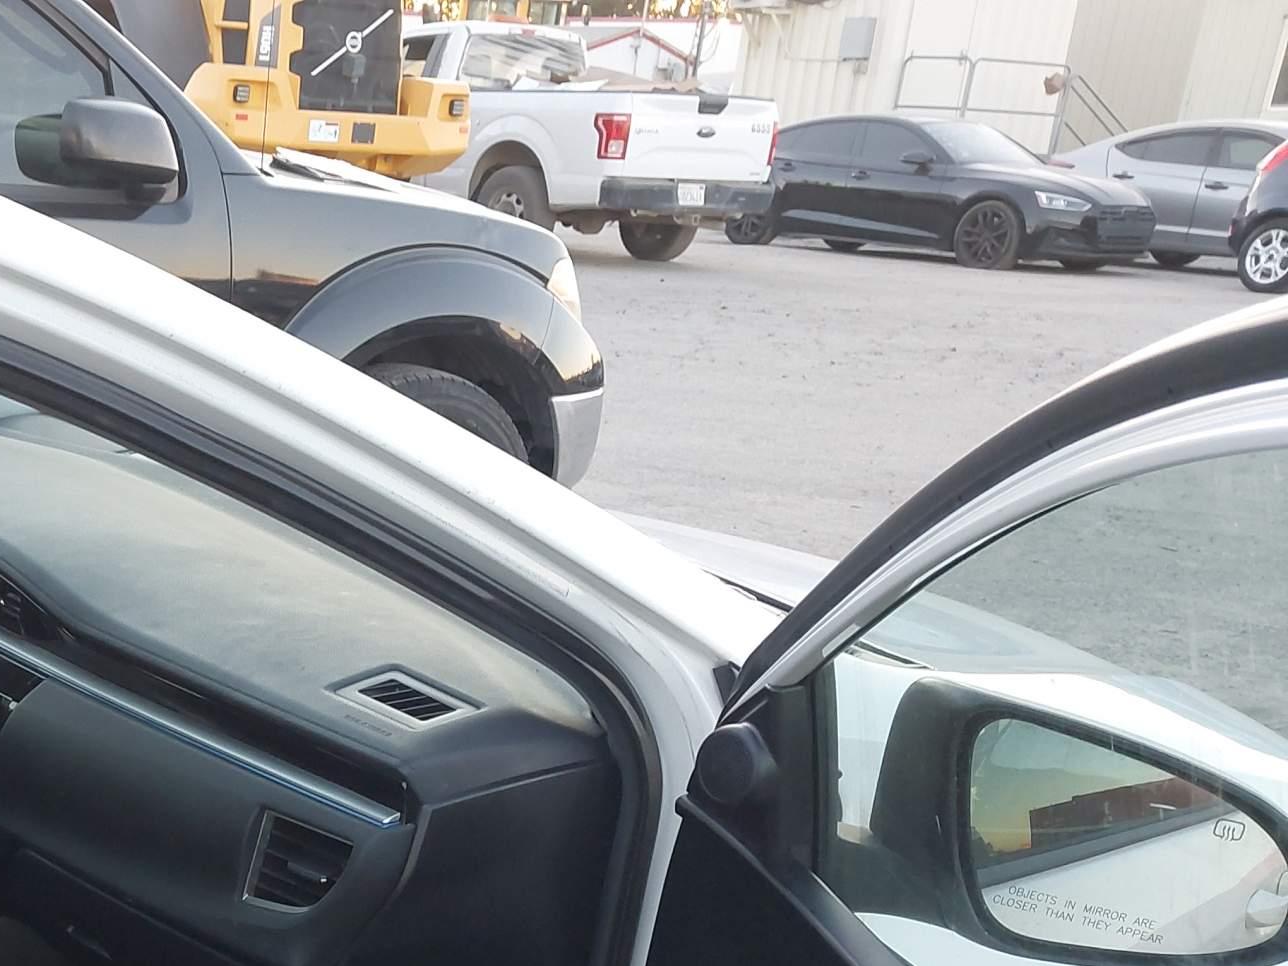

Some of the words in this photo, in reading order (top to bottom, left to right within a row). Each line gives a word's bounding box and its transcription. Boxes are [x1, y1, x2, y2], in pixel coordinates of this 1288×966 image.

[992, 894, 1038, 912] CLOSER
[1046, 907, 1074, 922] THAN
[1081, 916, 1112, 931] THEY
[1116, 926, 1164, 944] APPEAR
[1008, 885, 1058, 905] OBJECTS
[1064, 900, 1077, 910] IN
[1083, 905, 1128, 922] MIRROR
[1133, 917, 1157, 929] ARE
